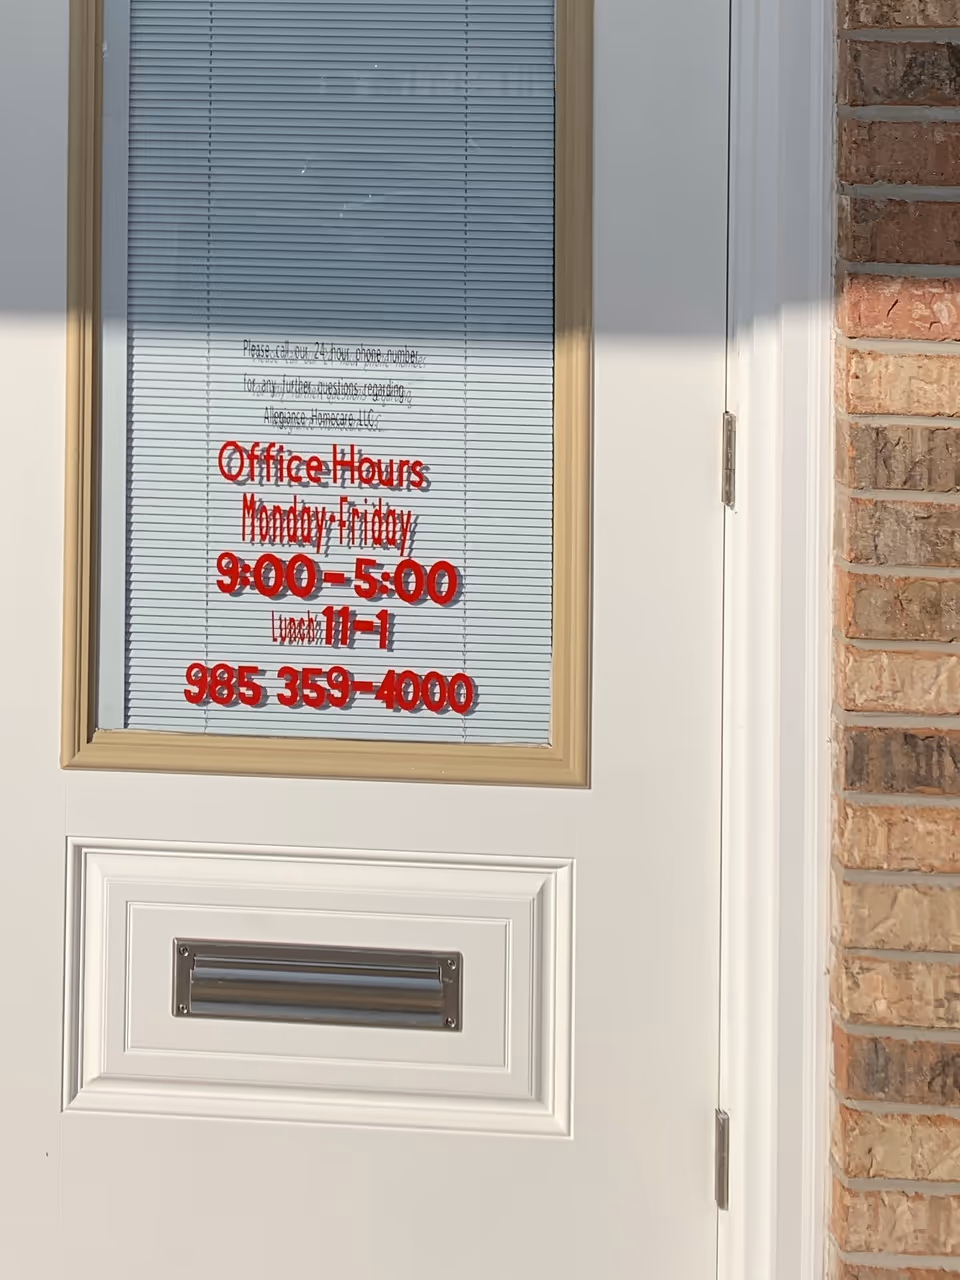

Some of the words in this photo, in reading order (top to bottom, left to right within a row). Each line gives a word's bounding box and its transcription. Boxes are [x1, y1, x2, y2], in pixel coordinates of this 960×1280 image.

[243, 338, 270, 359] Please
[275, 340, 290, 359] call
[295, 345, 309, 360] our
[330, 342, 350, 362] hour
[355, 343, 382, 365] phone
[387, 345, 419, 364] number
[243, 373, 256, 393] for
[262, 379, 277, 398] any
[282, 374, 312, 395] further
[317, 377, 359, 400] questions
[363, 379, 405, 404] regarding
[263, 406, 306, 430] Allegiance
[311, 408, 354, 427] Homecare
[217, 440, 324, 484] Office
[331, 443, 425, 489] Hours
[271, 609, 316, 643] Lunch
[321, 605, 389, 650] 11-1
[183, 662, 262, 707] 985
[276, 665, 474, 716] 359-4000
